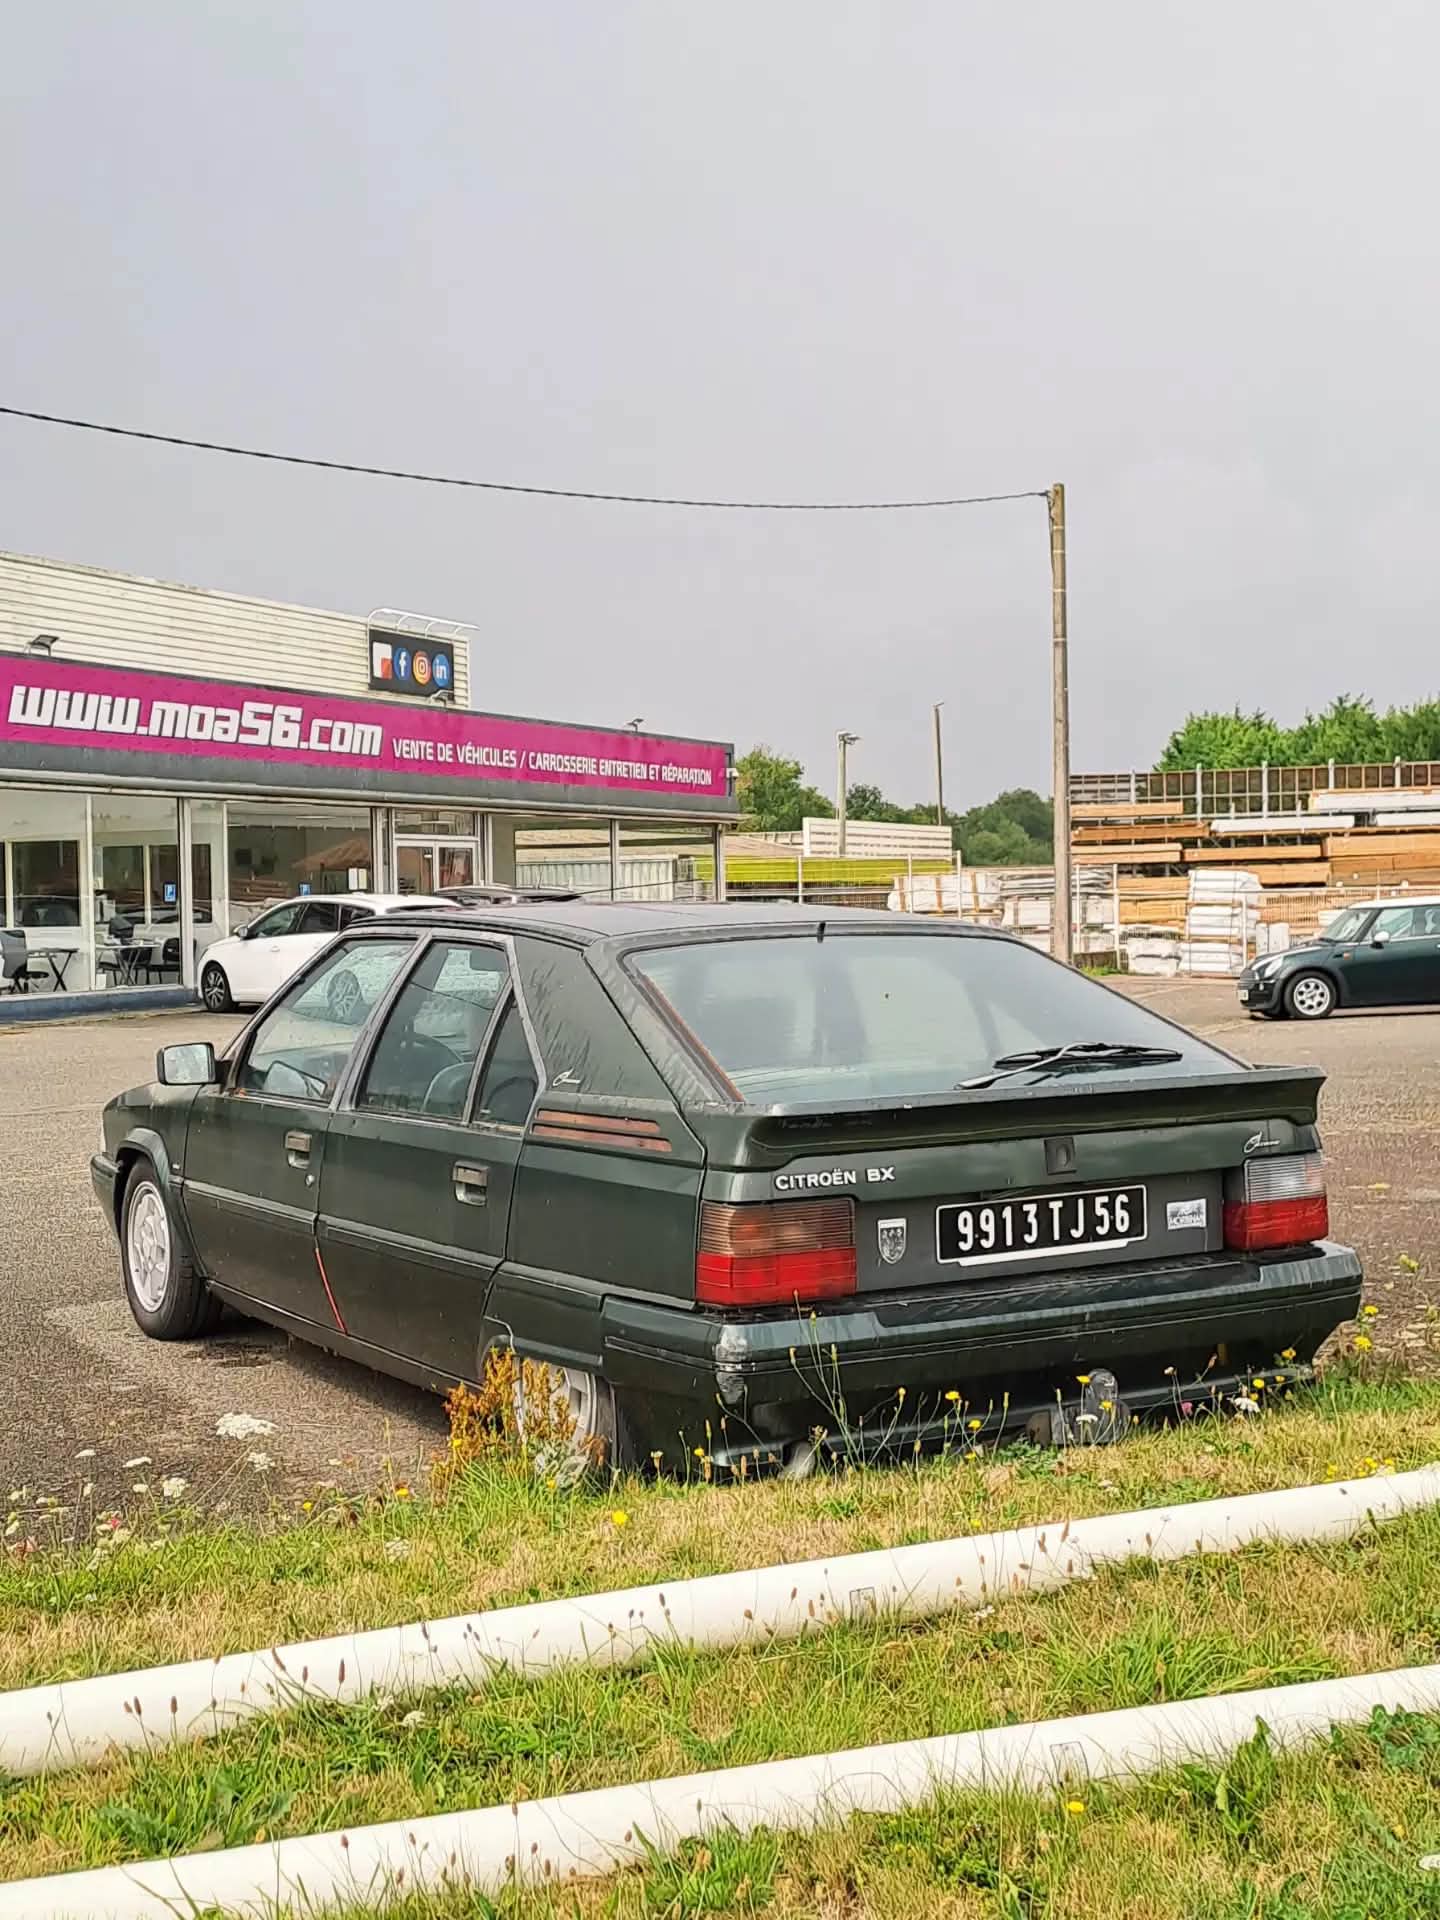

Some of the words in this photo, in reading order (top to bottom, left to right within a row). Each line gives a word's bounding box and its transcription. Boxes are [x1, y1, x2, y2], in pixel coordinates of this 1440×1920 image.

[393, 738, 434, 761] VENTE
[437, 742, 453, 763] DE
[456, 741, 517, 767] VÉHICULES
[528, 752, 597, 776] CARROSSERIE
[599, 759, 647, 780] ENTRETIEN
[649, 765, 660, 781] ET
[661, 762, 712, 785] RÉPARATION
[775, 1168, 857, 1190] CITROËN
[866, 1166, 896, 1182] BX
